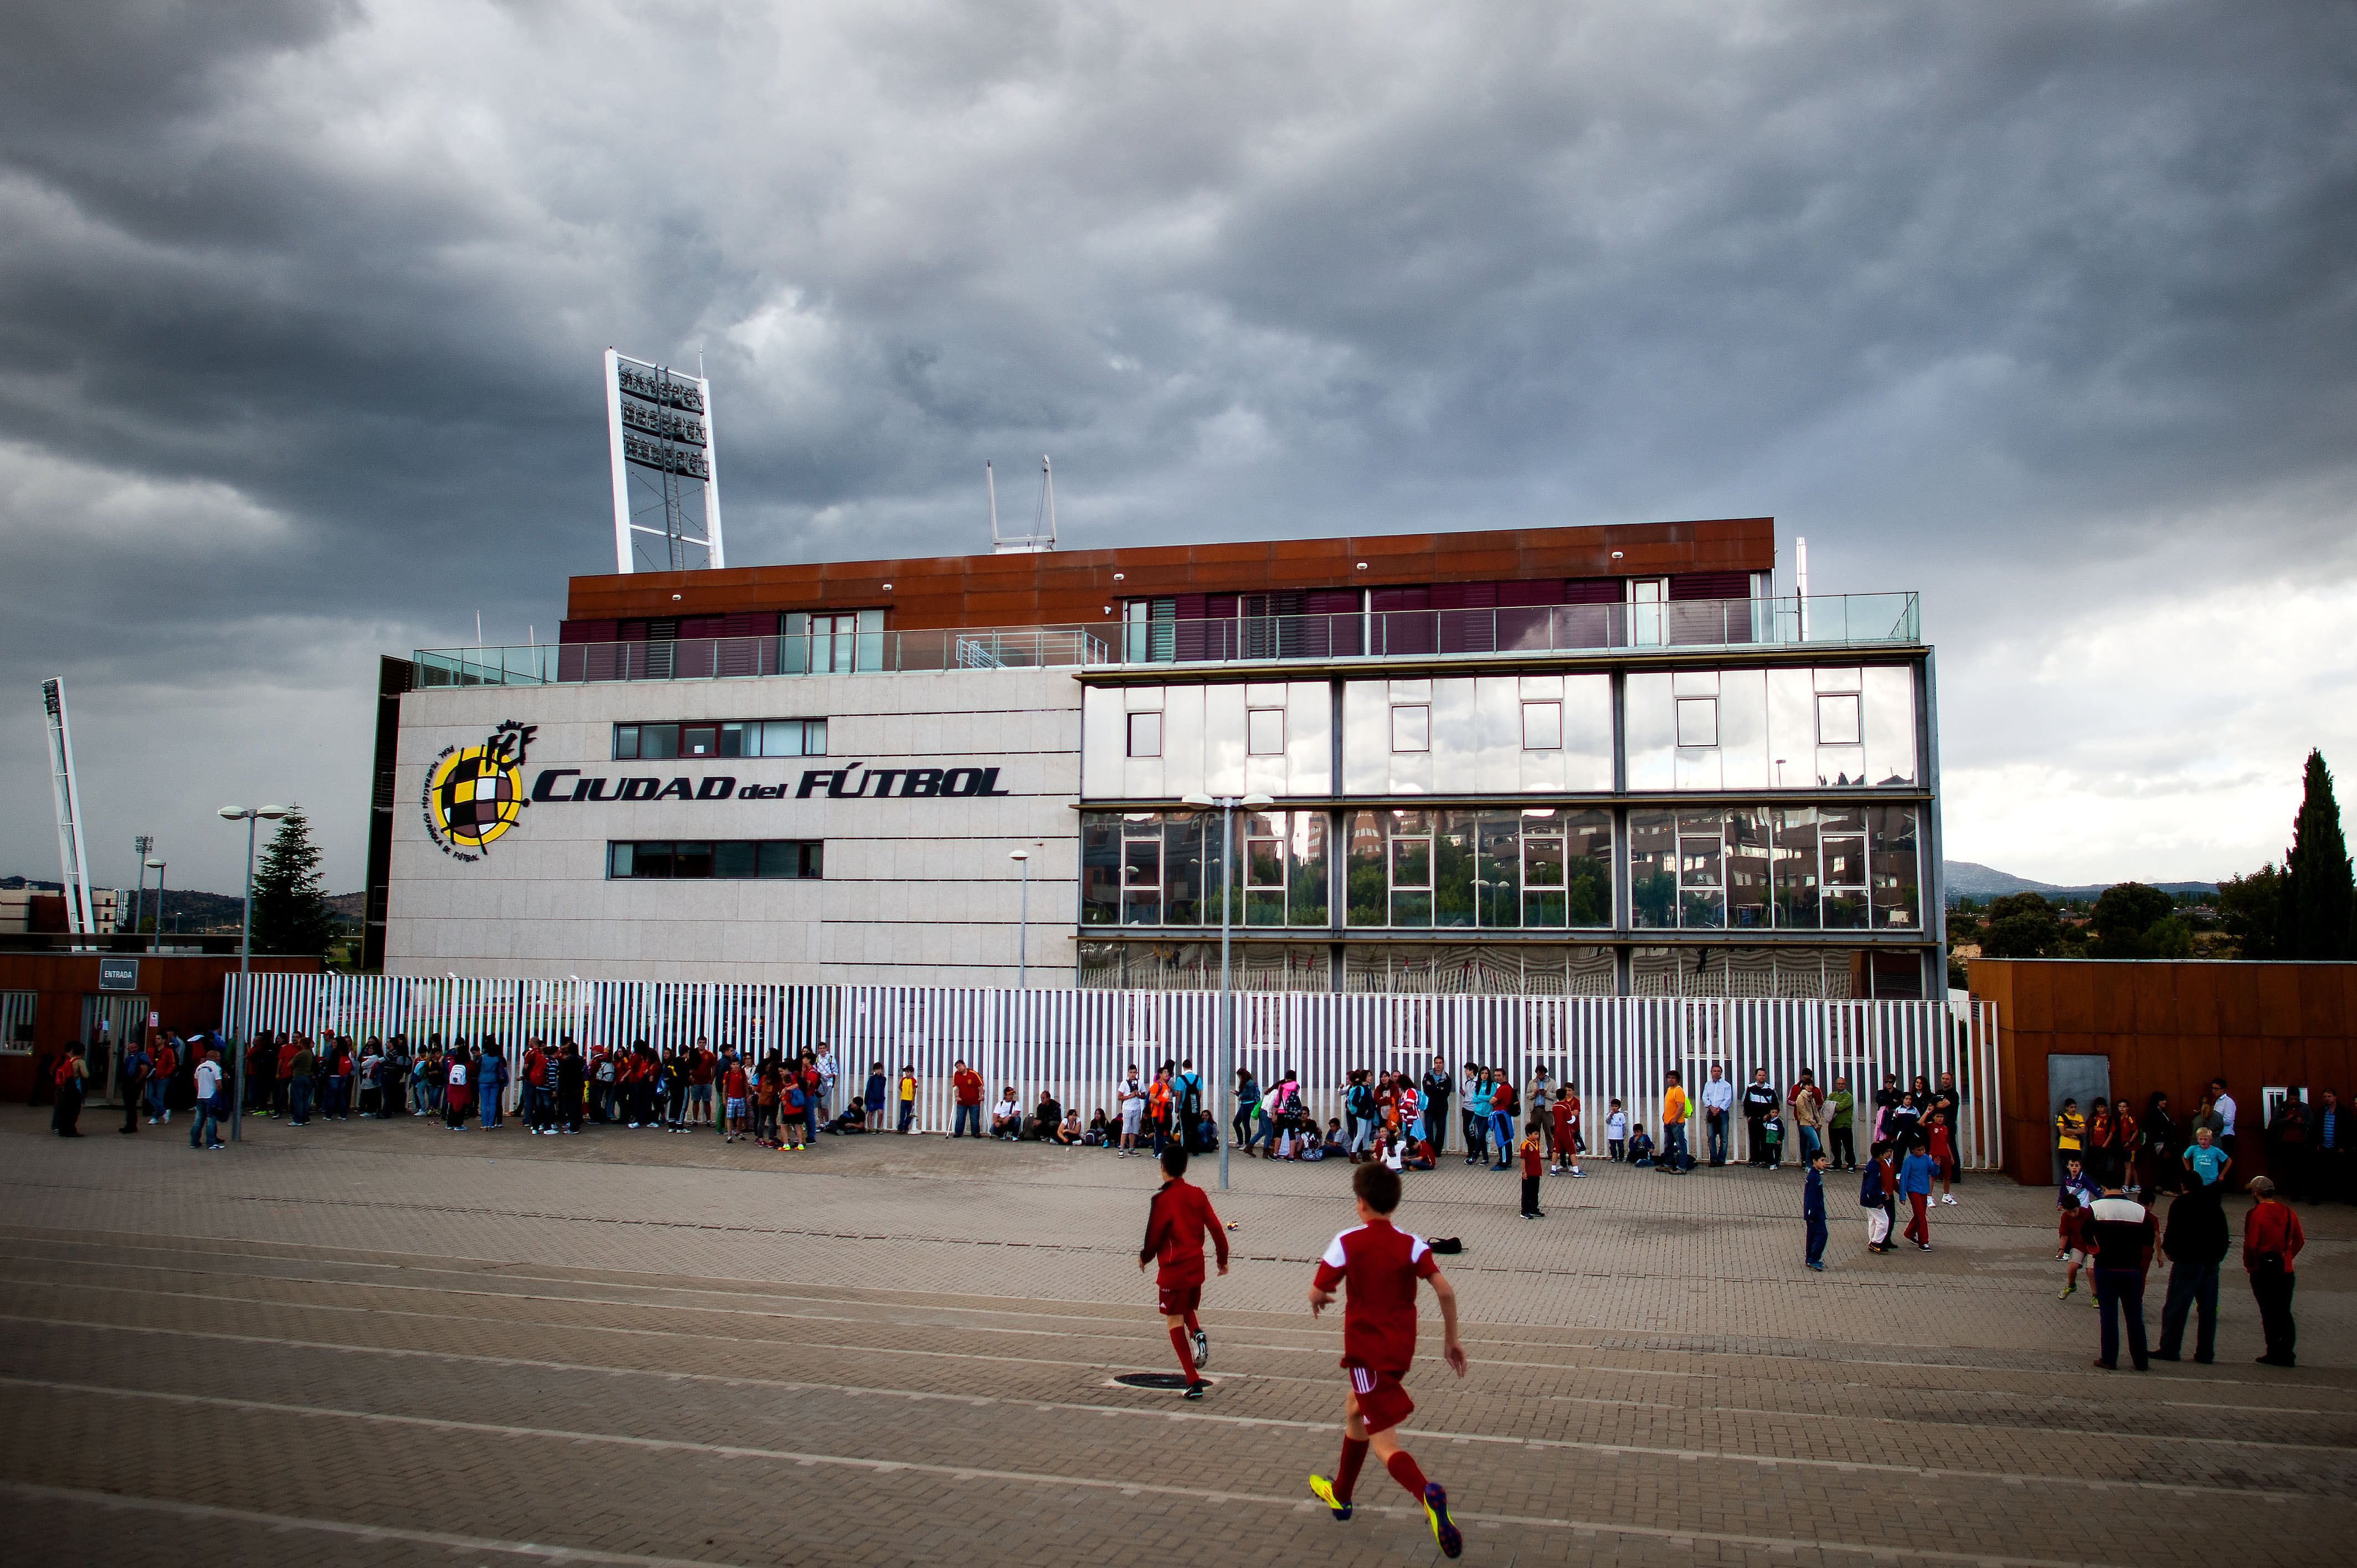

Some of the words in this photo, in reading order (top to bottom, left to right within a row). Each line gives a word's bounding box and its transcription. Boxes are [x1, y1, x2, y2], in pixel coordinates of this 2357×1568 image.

[438, 744, 455, 759] REAL
[738, 783, 789, 800] del
[795, 761, 1009, 798] FÚTBOL
[442, 845, 451, 854] DE
[104, 970, 132, 979] ENTRADA
